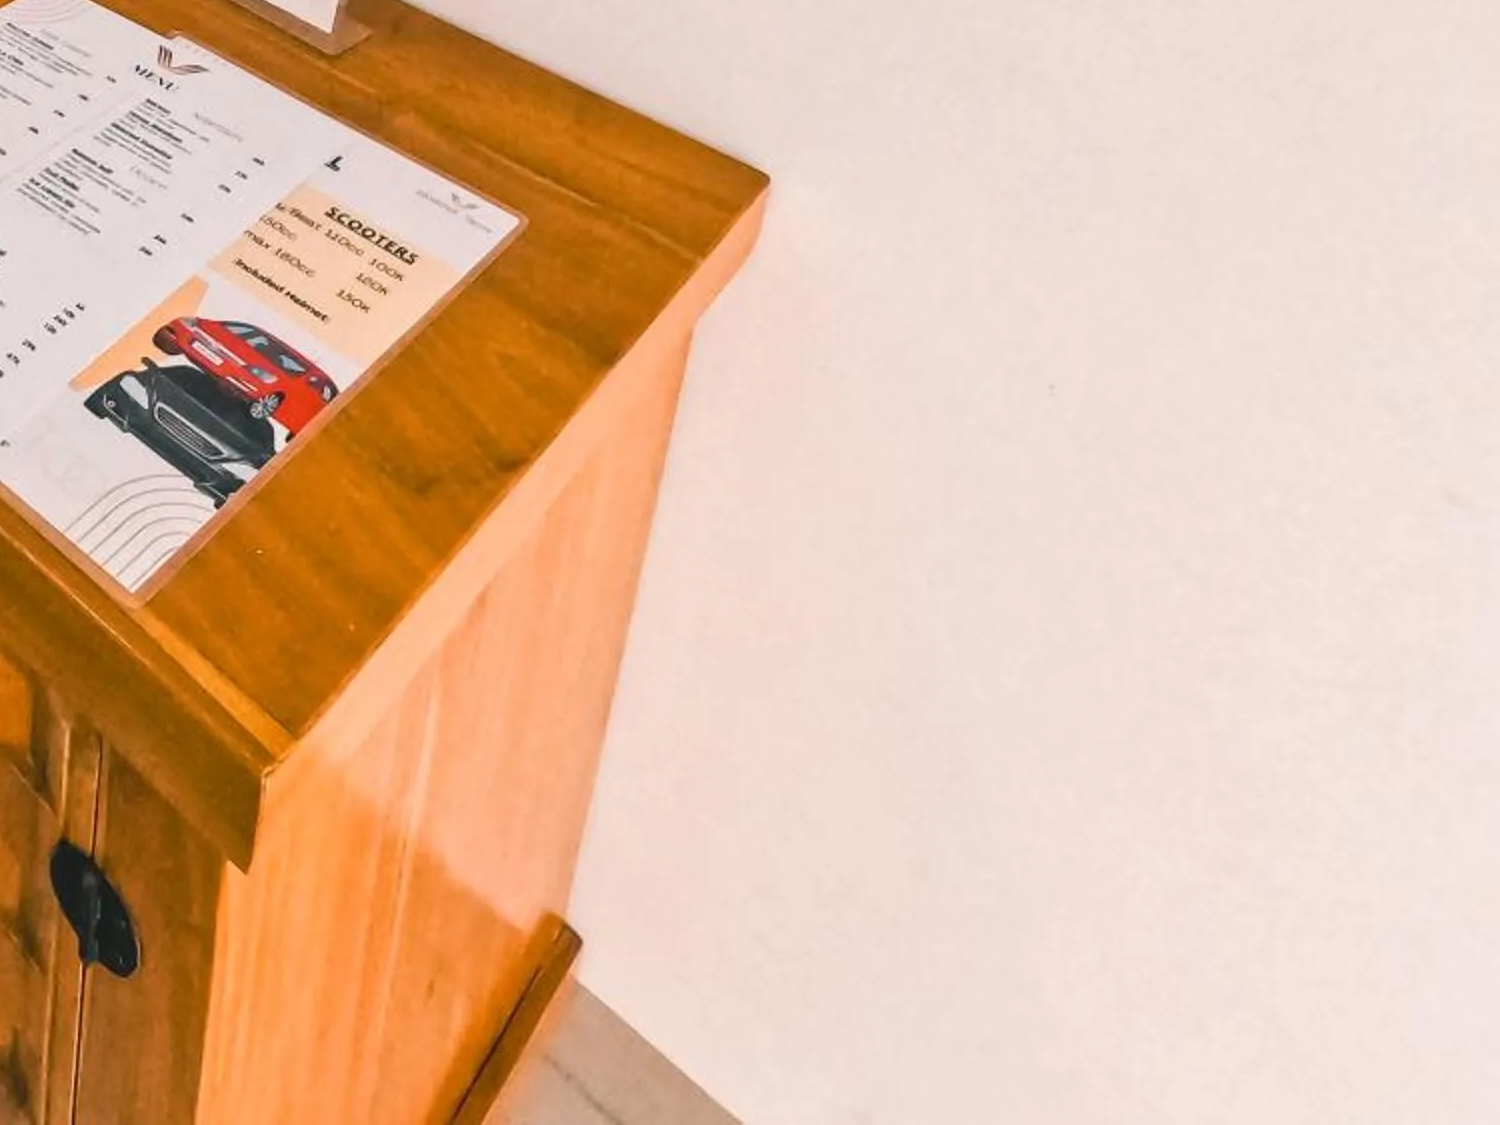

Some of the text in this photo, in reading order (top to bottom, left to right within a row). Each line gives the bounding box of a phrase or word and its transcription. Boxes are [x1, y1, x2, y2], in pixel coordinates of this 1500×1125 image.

[135, 65, 180, 91] MENU
[324, 207, 419, 265] SCOOTERS
[234, 258, 285, 293] Included
